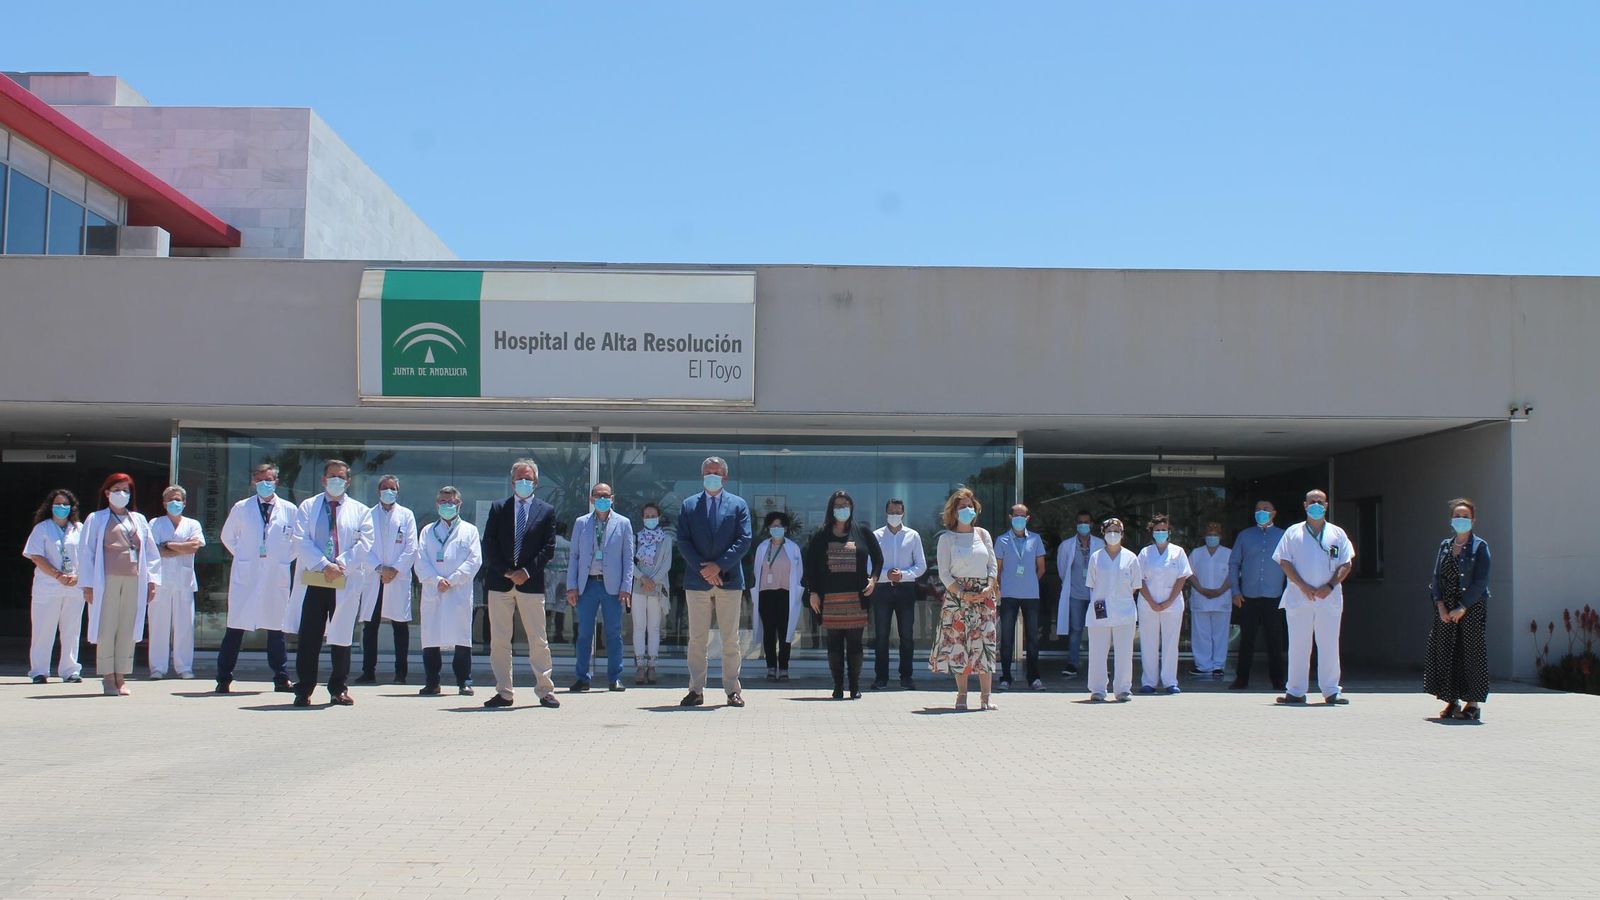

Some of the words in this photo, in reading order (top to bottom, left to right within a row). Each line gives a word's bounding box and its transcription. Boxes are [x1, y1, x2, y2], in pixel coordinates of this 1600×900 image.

[494, 330, 568, 354] Hospital
[574, 331, 596, 351] de
[601, 332, 637, 352] Alta
[643, 332, 742, 353] Resolución
[393, 367, 415, 376] JUNTA
[418, 367, 427, 376] DE
[689, 359, 702, 378] El
[707, 360, 742, 383] Toyo
